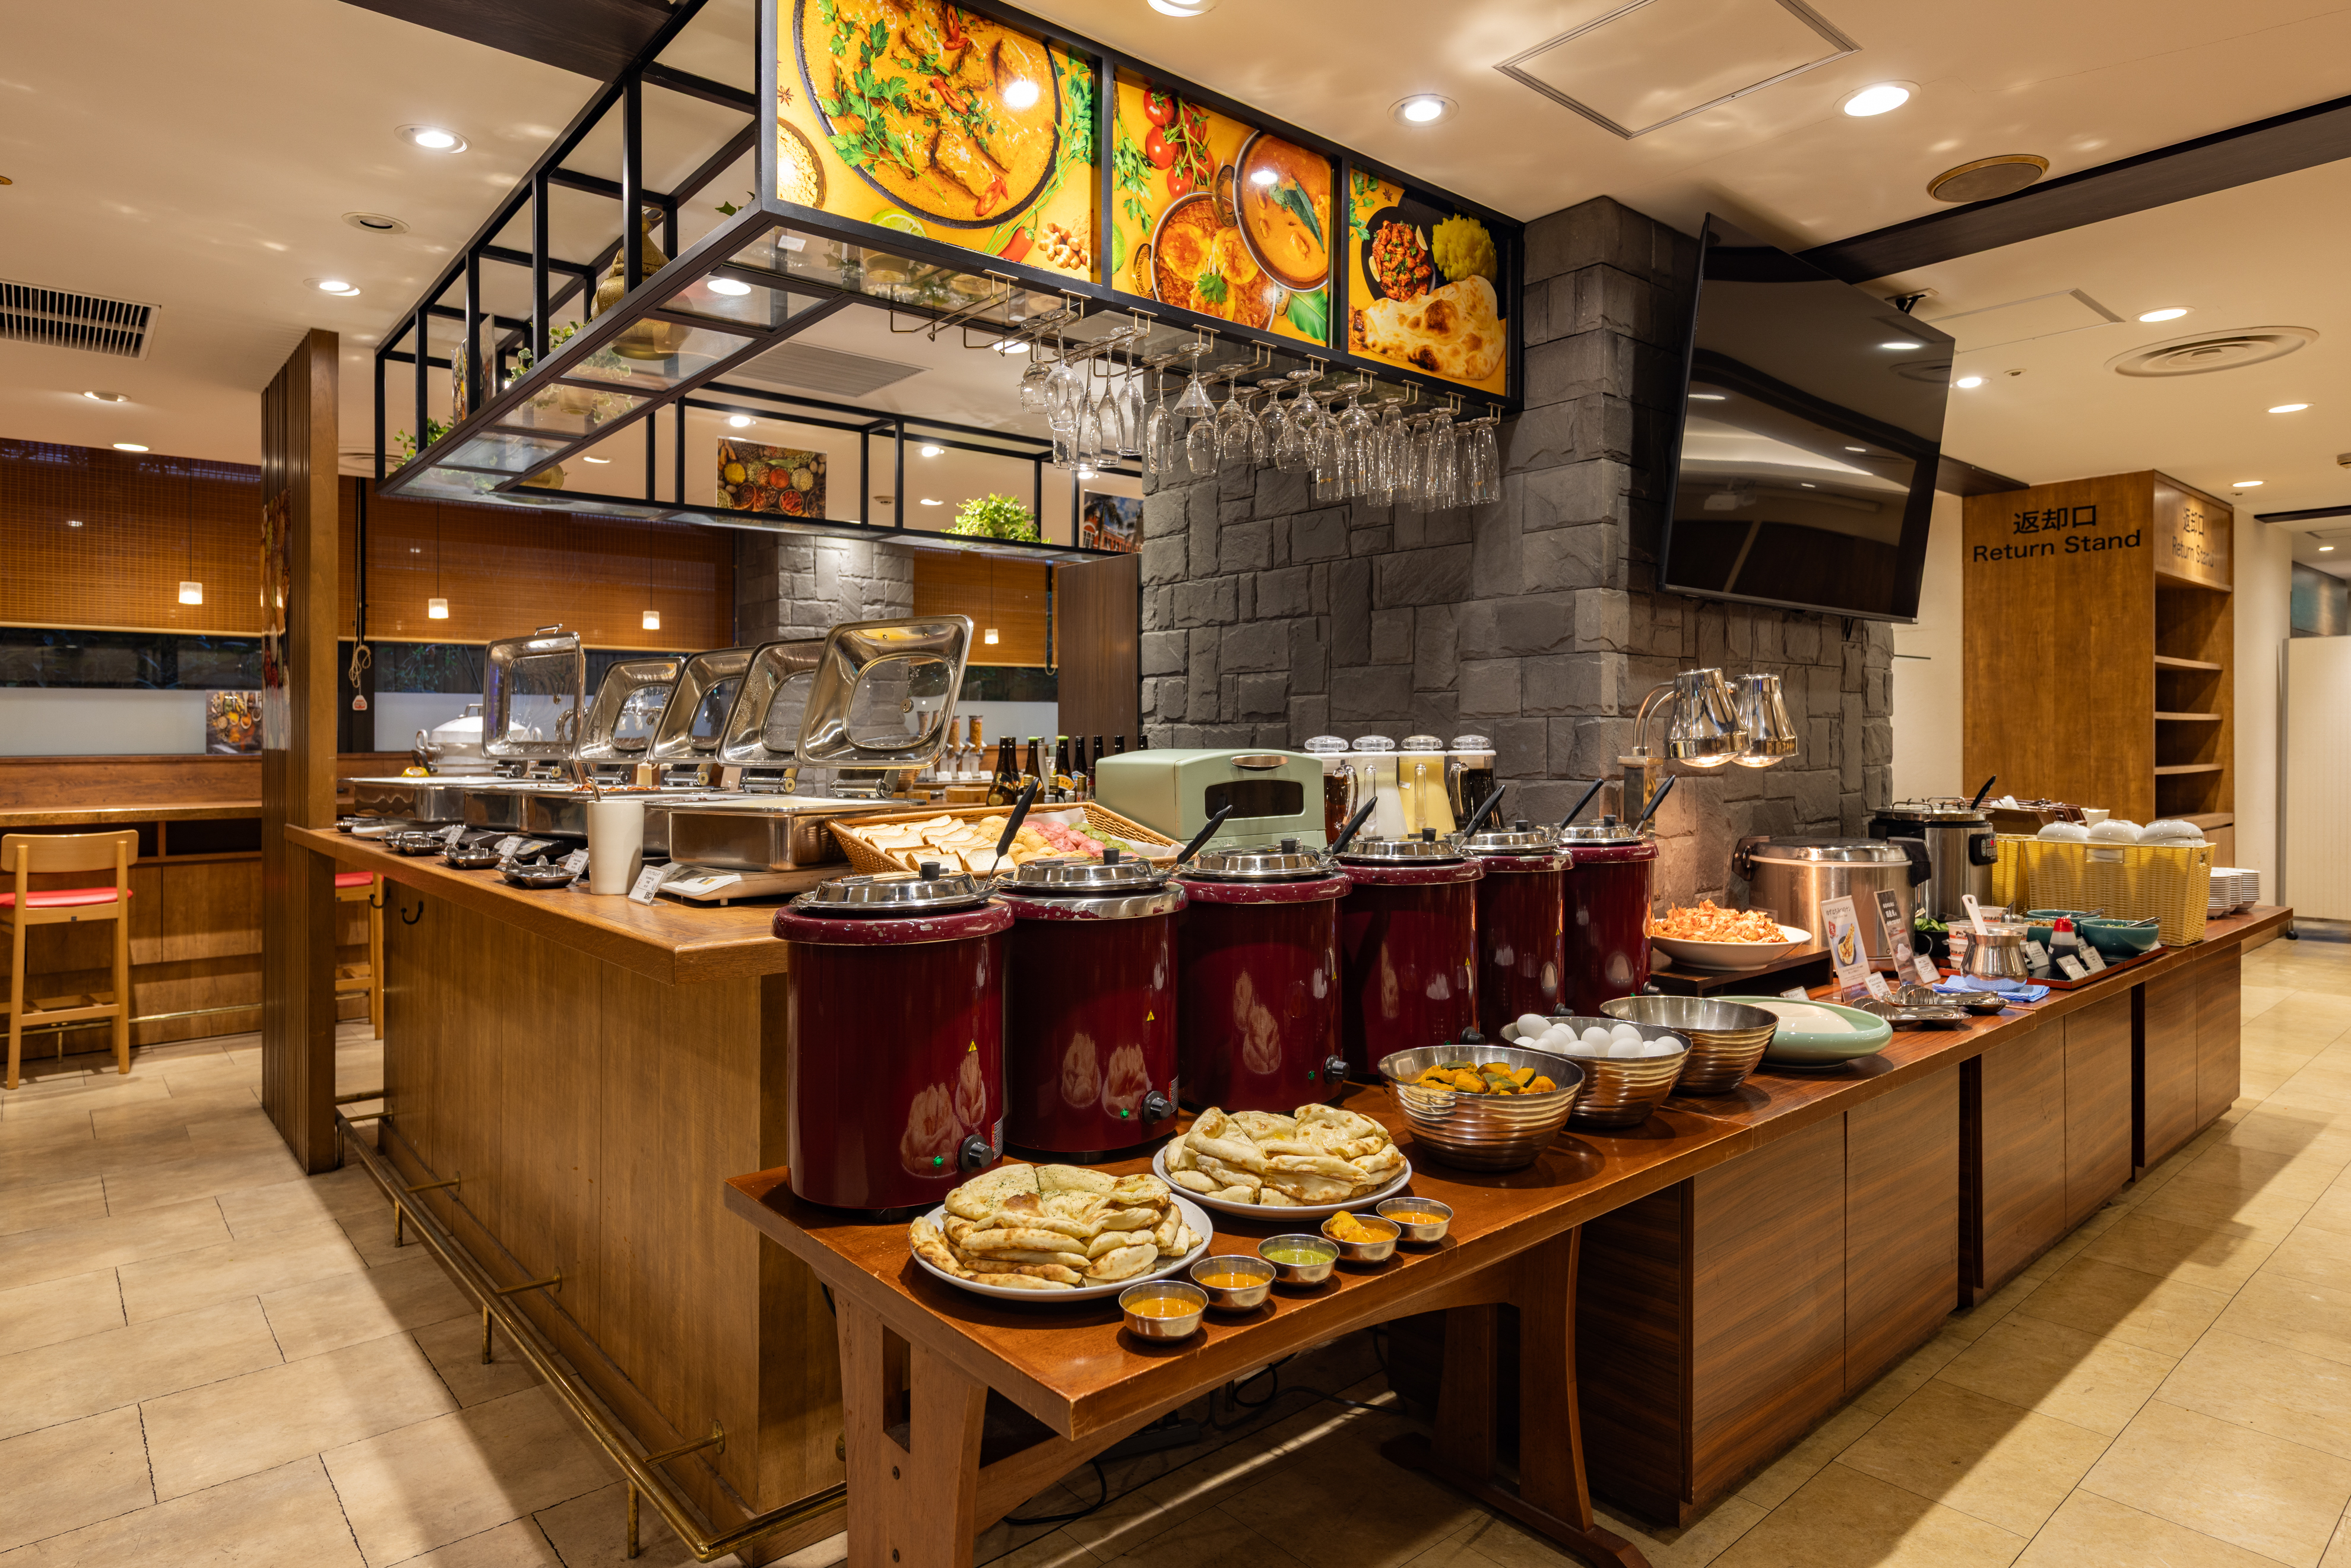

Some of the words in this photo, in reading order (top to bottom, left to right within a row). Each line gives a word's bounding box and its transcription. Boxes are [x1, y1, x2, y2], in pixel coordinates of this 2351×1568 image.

[2013, 505, 2096, 535] 返却口
[2183, 507, 2204, 537] 返却口
[1973, 541, 2054, 562] Return
[2064, 529, 2140, 553] Stand
[2172, 536, 2194, 562] Return
